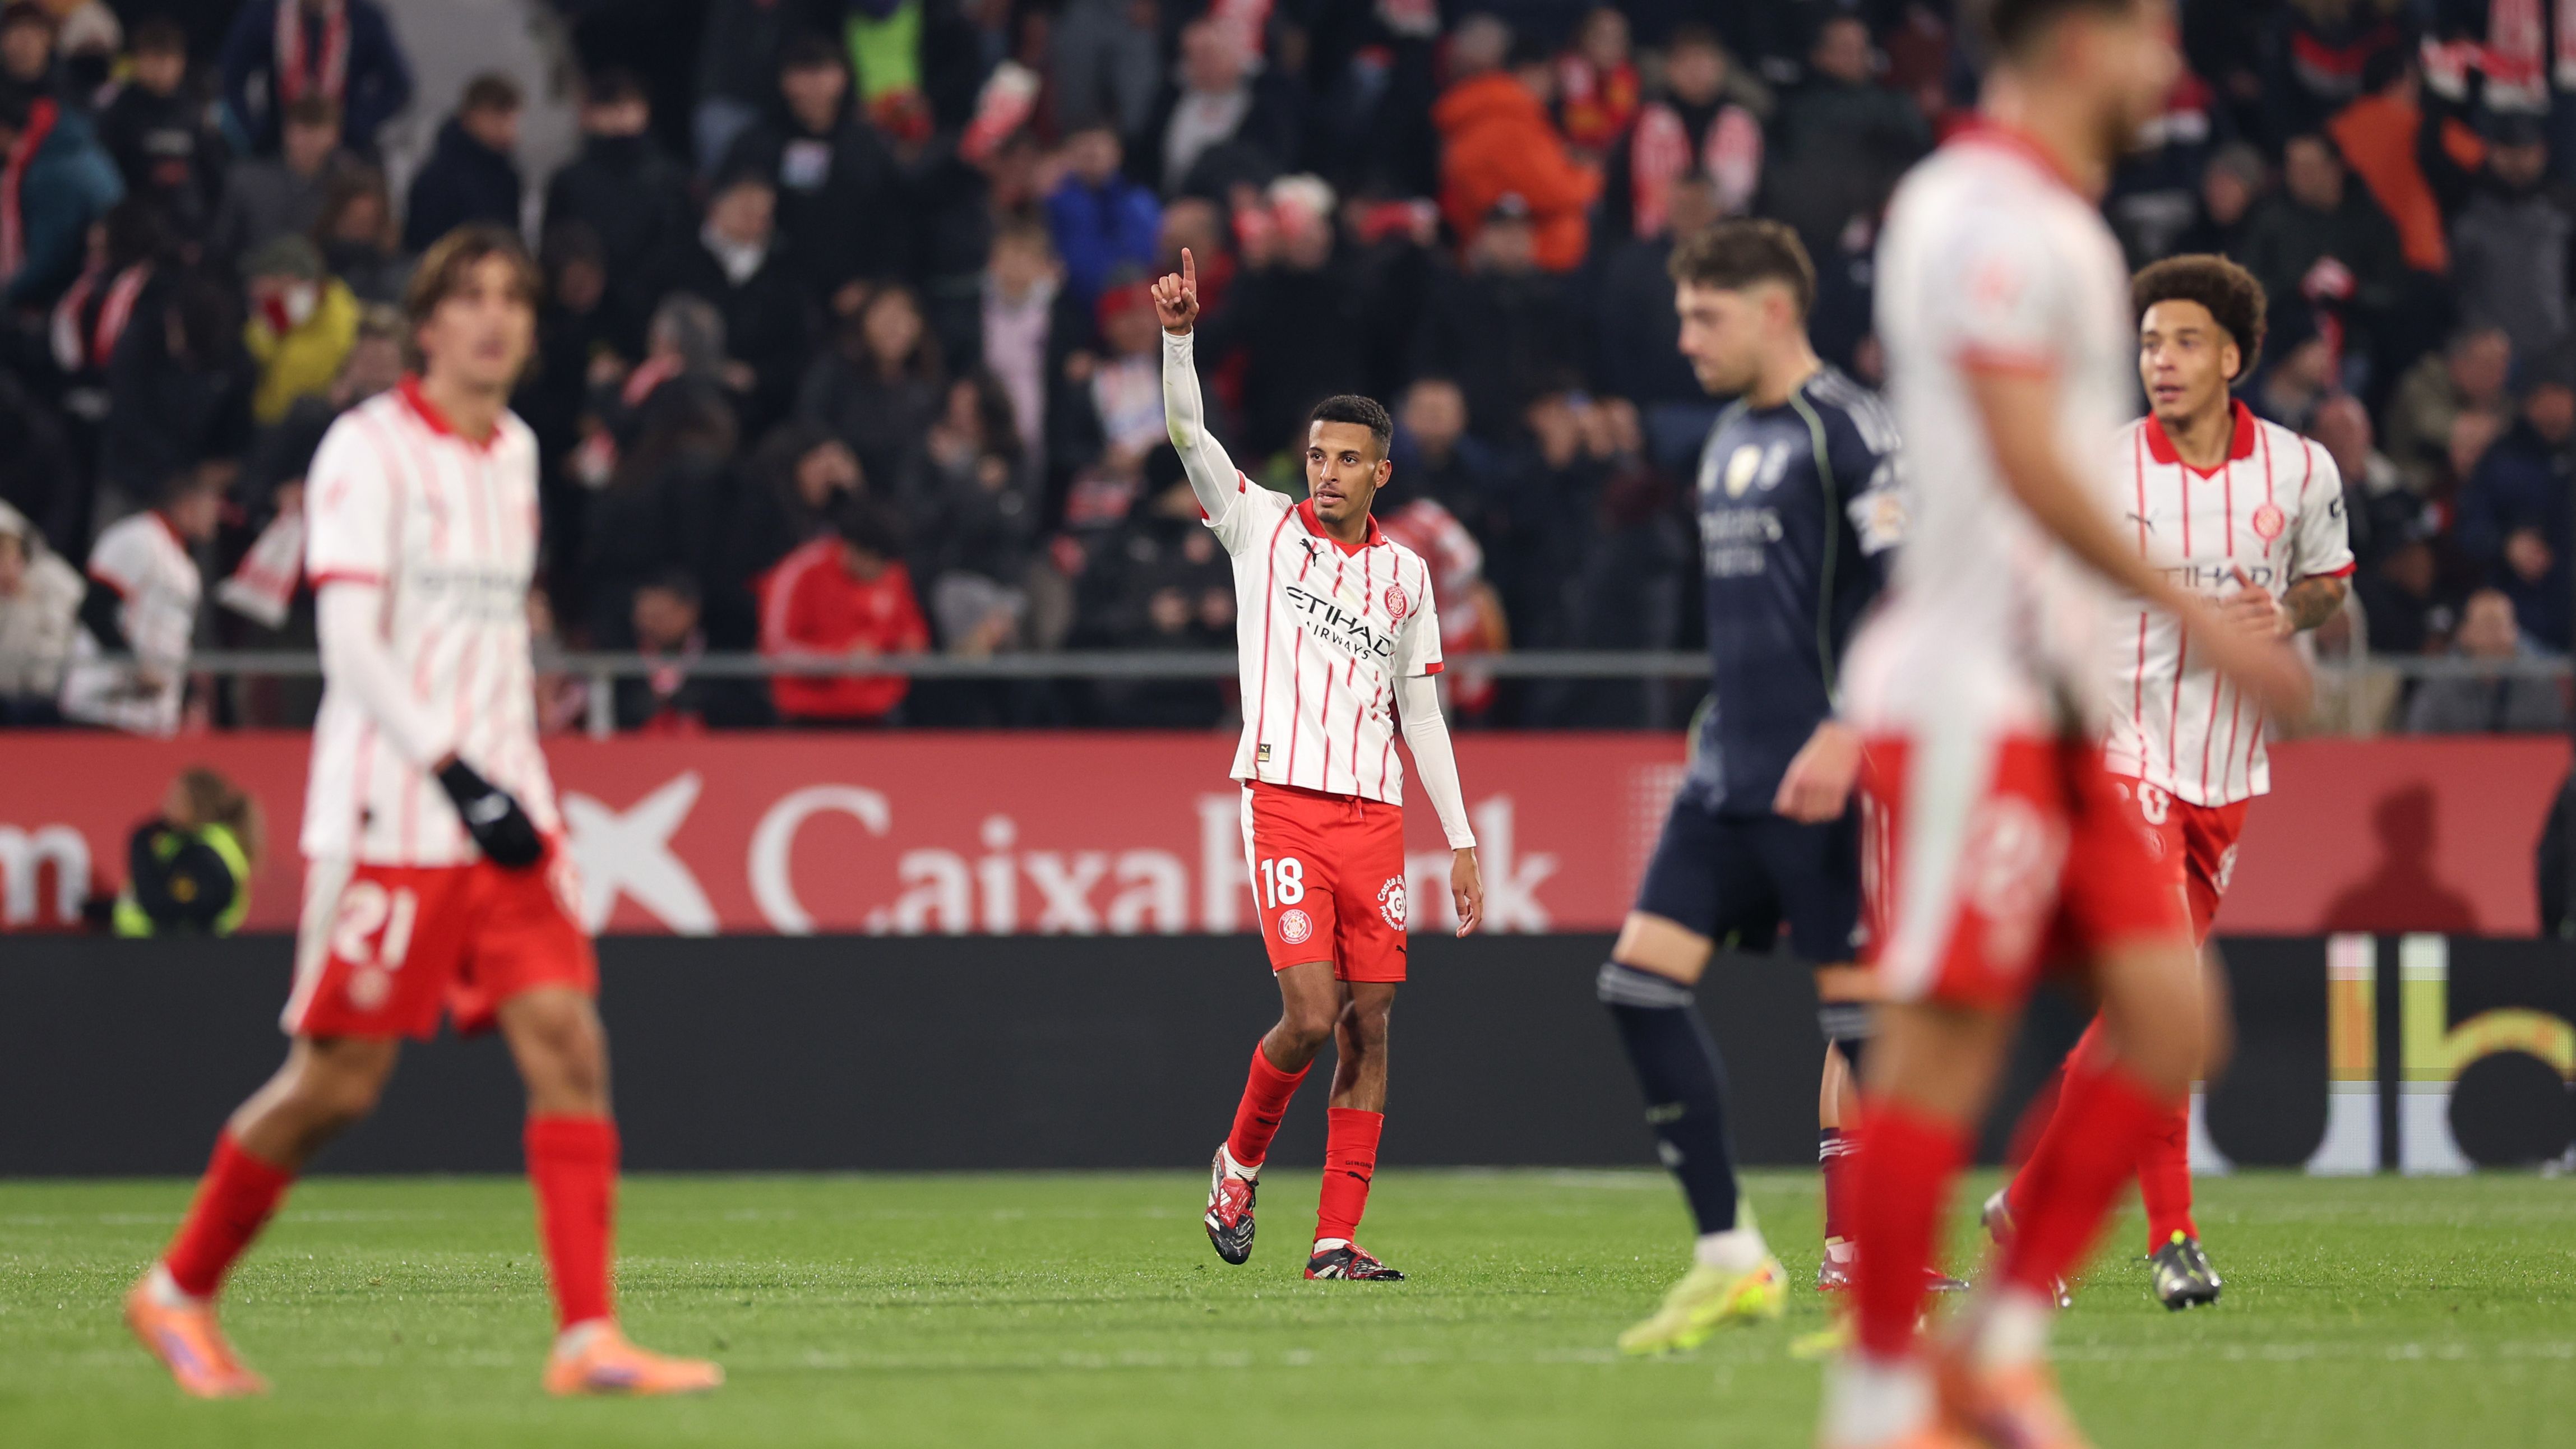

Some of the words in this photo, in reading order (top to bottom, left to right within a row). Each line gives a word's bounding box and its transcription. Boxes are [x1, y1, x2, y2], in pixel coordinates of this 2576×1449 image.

[1286, 586, 1390, 657] ETIHAD
[747, 782, 1560, 936] Caixank
[1260, 857, 1305, 909] 18
[1282, 910, 1304, 921] GIRONA
[1377, 877, 1396, 902] Costa
[332, 878, 419, 971] 21
[1379, 905, 1398, 930] Pirineu
